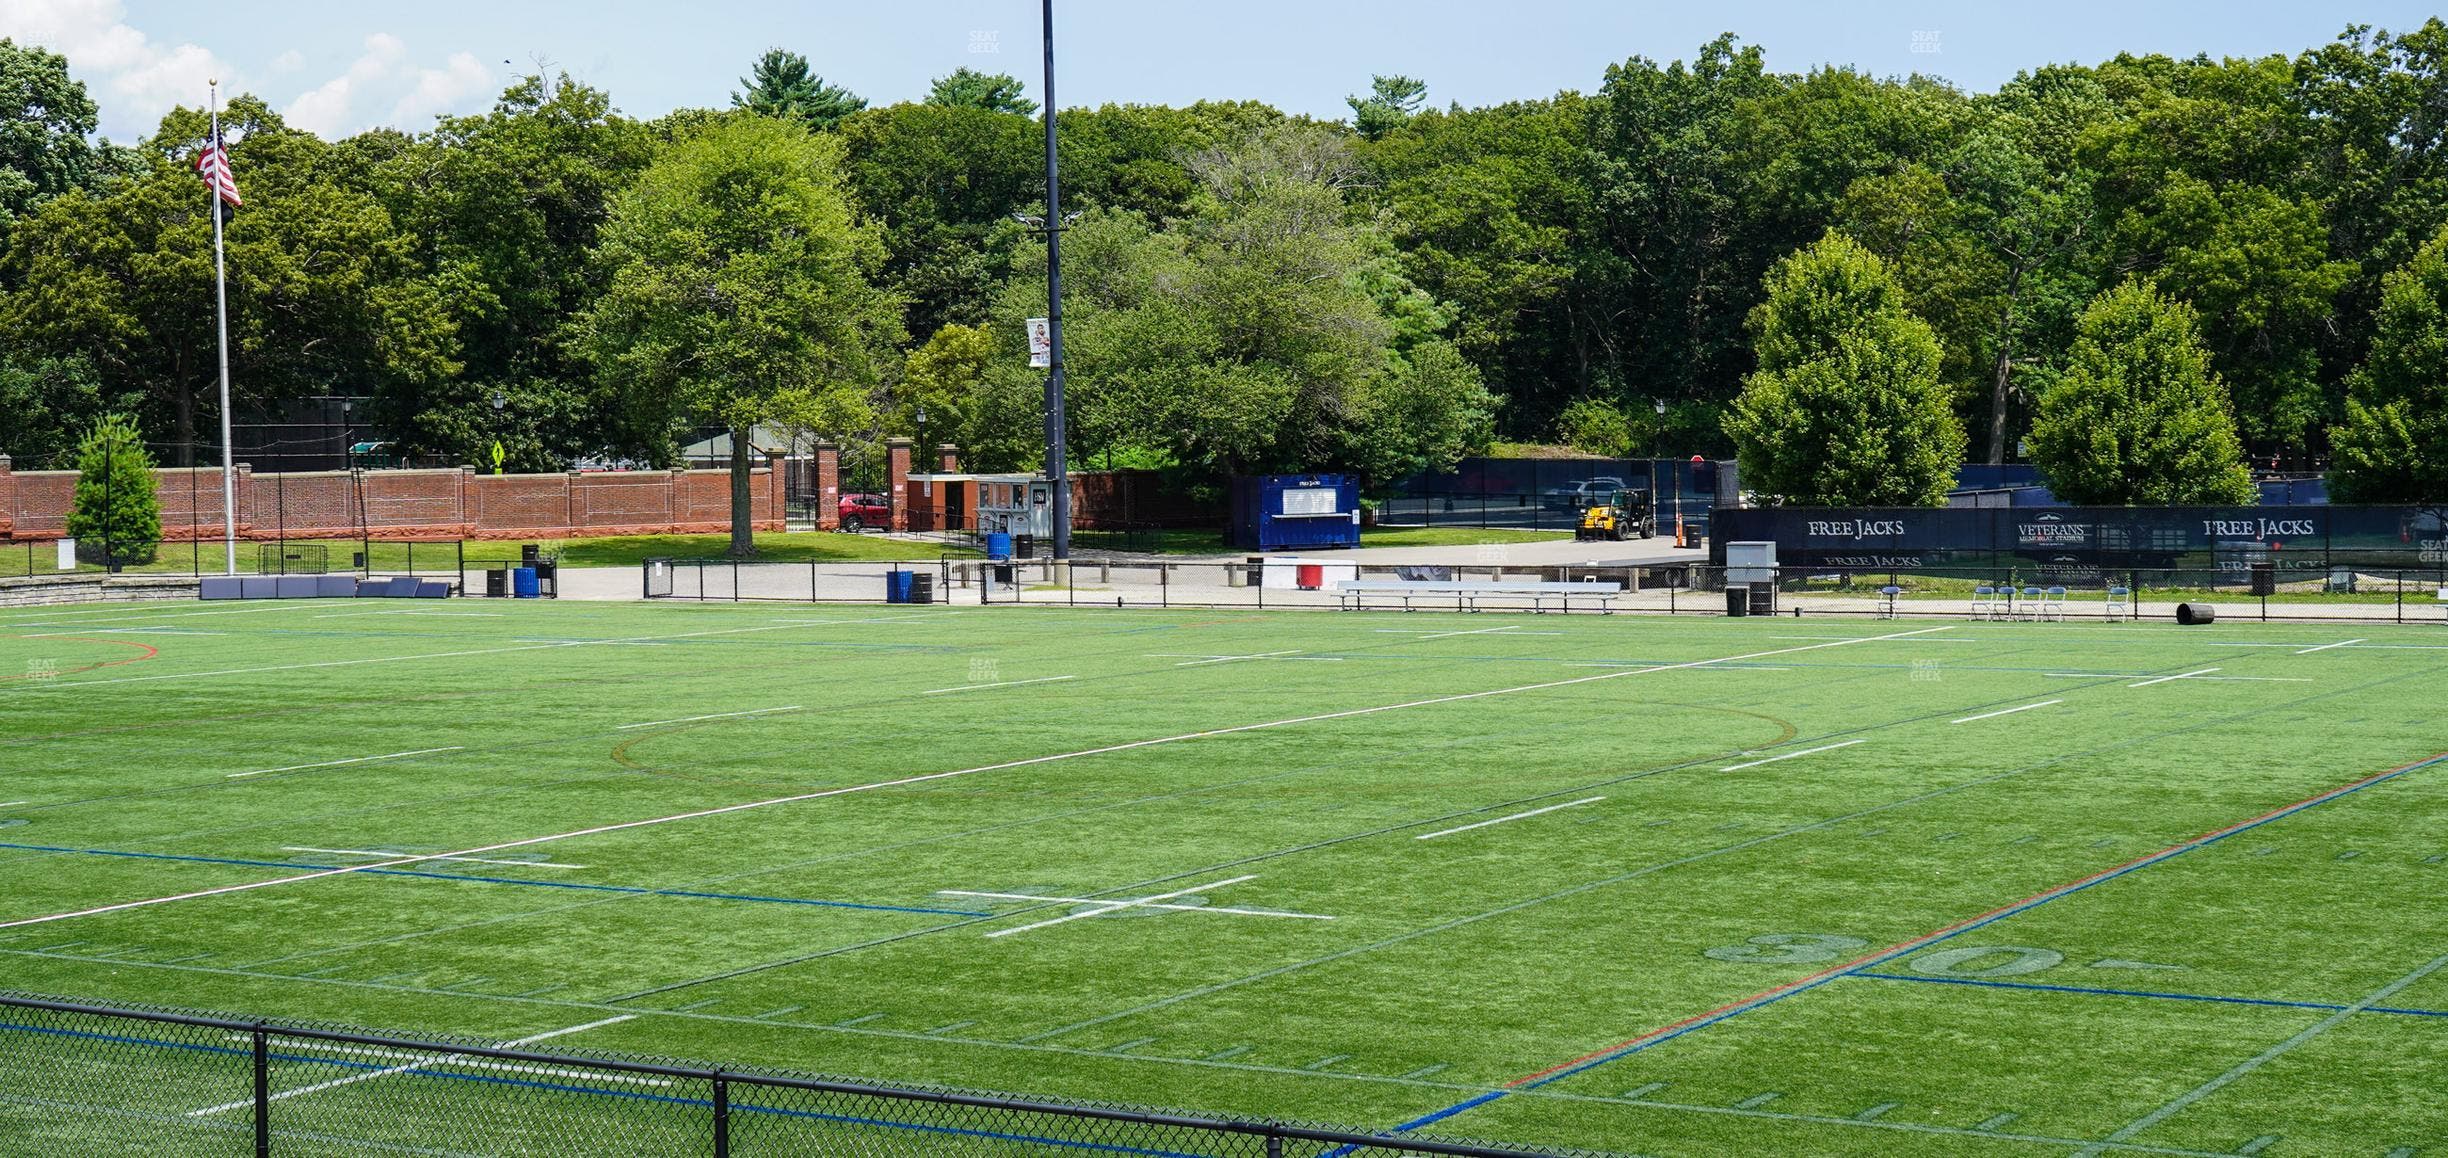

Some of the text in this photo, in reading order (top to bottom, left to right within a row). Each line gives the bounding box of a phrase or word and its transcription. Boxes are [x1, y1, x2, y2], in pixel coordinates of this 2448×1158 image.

[1808, 519, 1904, 540] FREE JACKS
[2018, 524, 2084, 535] VETERANS
[2203, 518, 2313, 540] FREE JACKS
